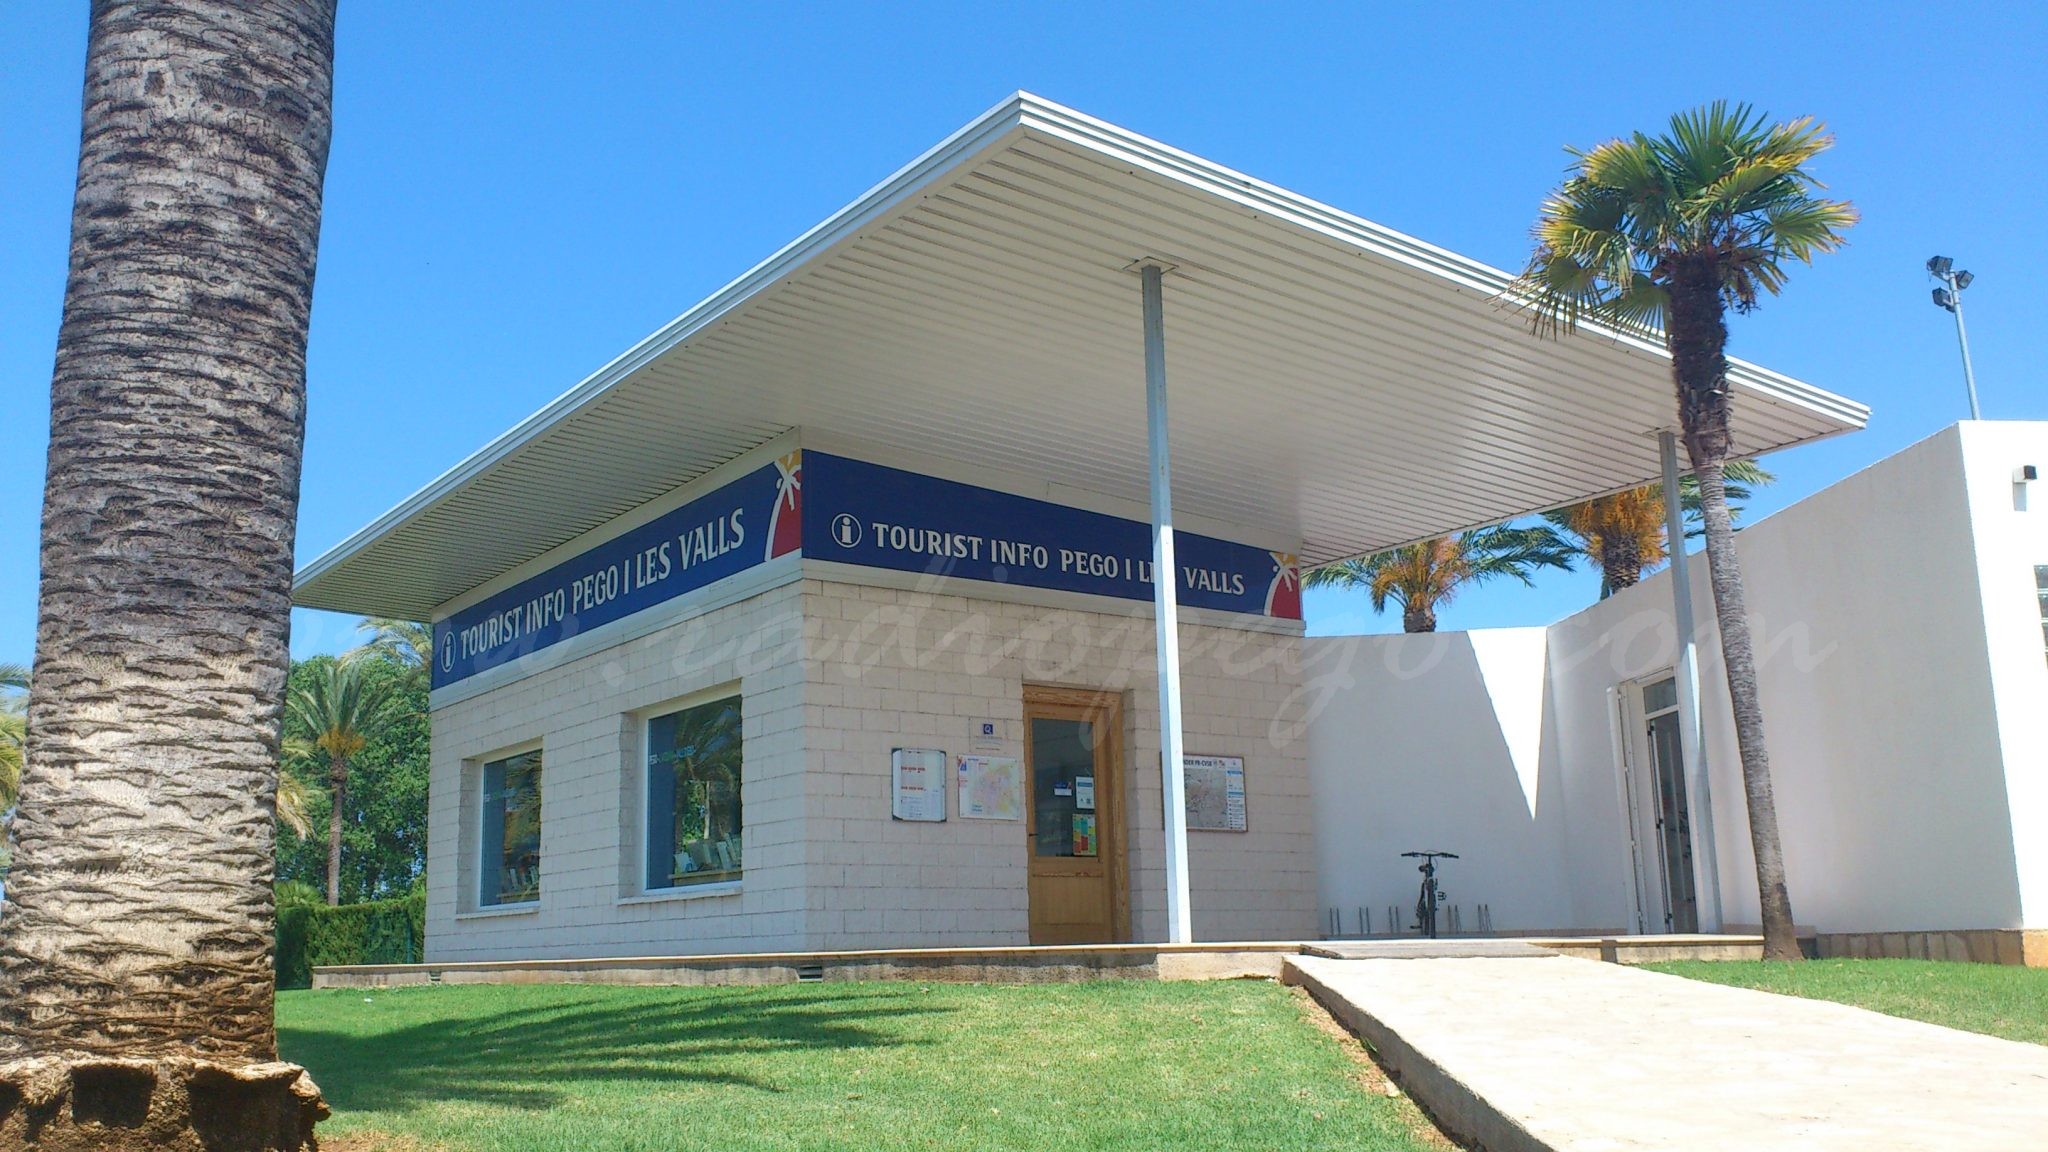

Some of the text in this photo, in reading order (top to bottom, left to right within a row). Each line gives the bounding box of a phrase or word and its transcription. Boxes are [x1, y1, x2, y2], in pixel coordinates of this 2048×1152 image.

[460, 507, 745, 660] TOURIST INFO PEGO I LES VALLS
[872, 522, 983, 561] TOURIST
[991, 539, 1049, 570] INFO
[1060, 548, 1119, 579] PEGO
[1125, 557, 1132, 581] I
[1183, 566, 1245, 596] VALLS
